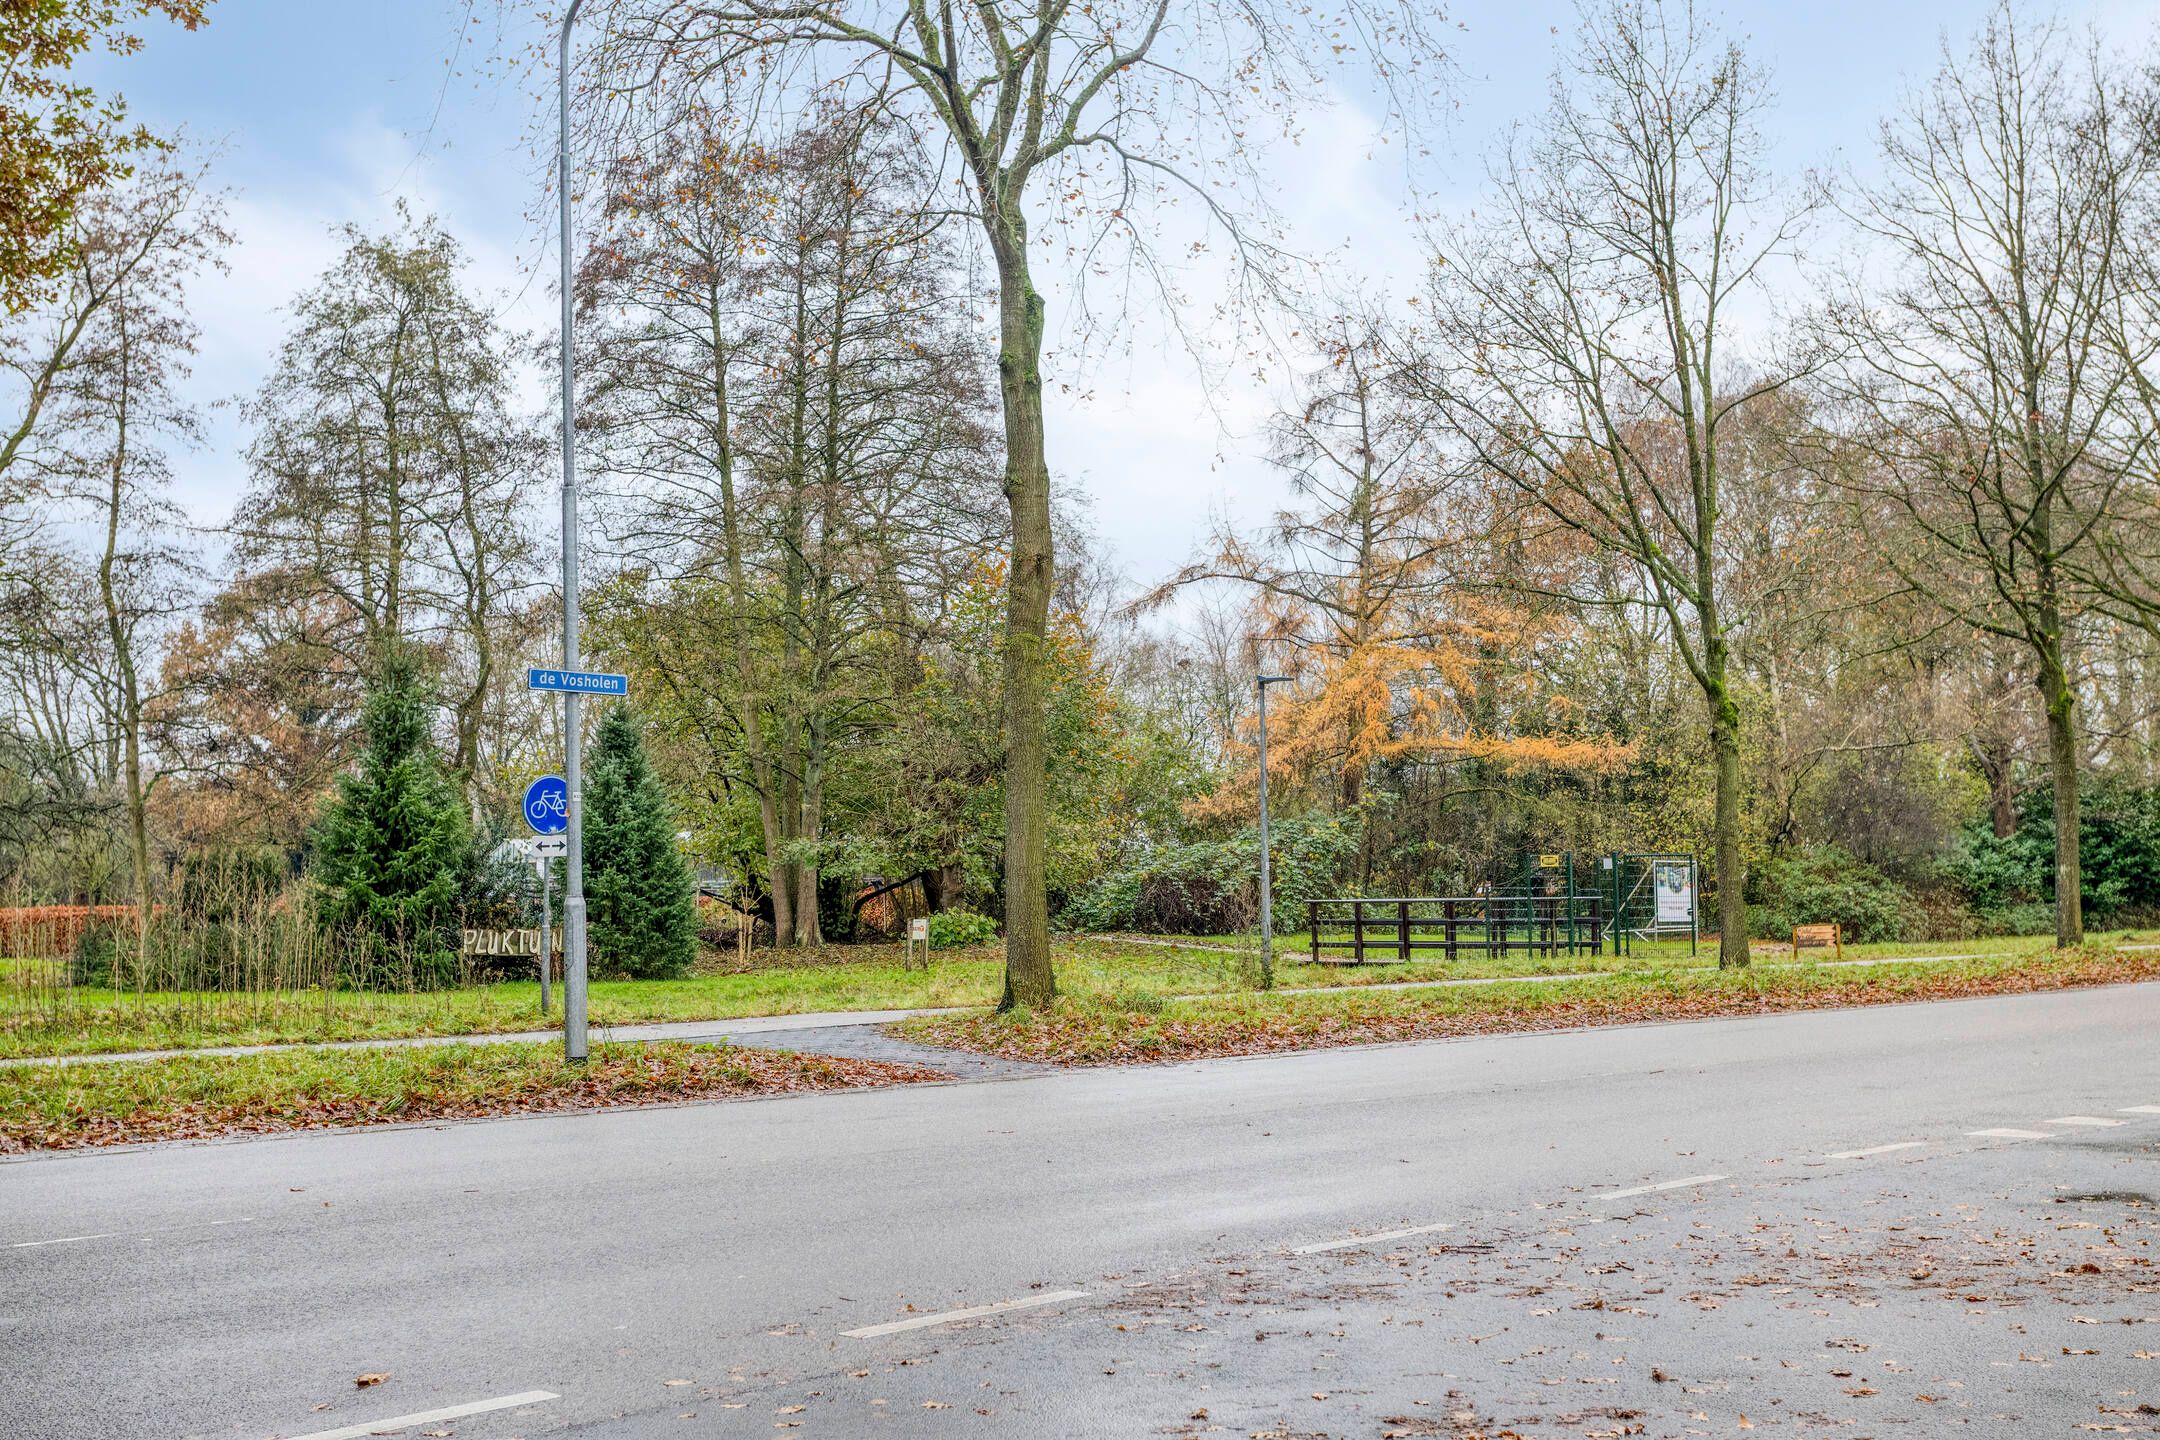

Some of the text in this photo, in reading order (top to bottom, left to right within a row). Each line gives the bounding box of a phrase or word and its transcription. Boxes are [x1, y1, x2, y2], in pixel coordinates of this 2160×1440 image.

[539, 672, 619, 690] de Vosholen
[463, 928, 563, 955] PLUKTUN
